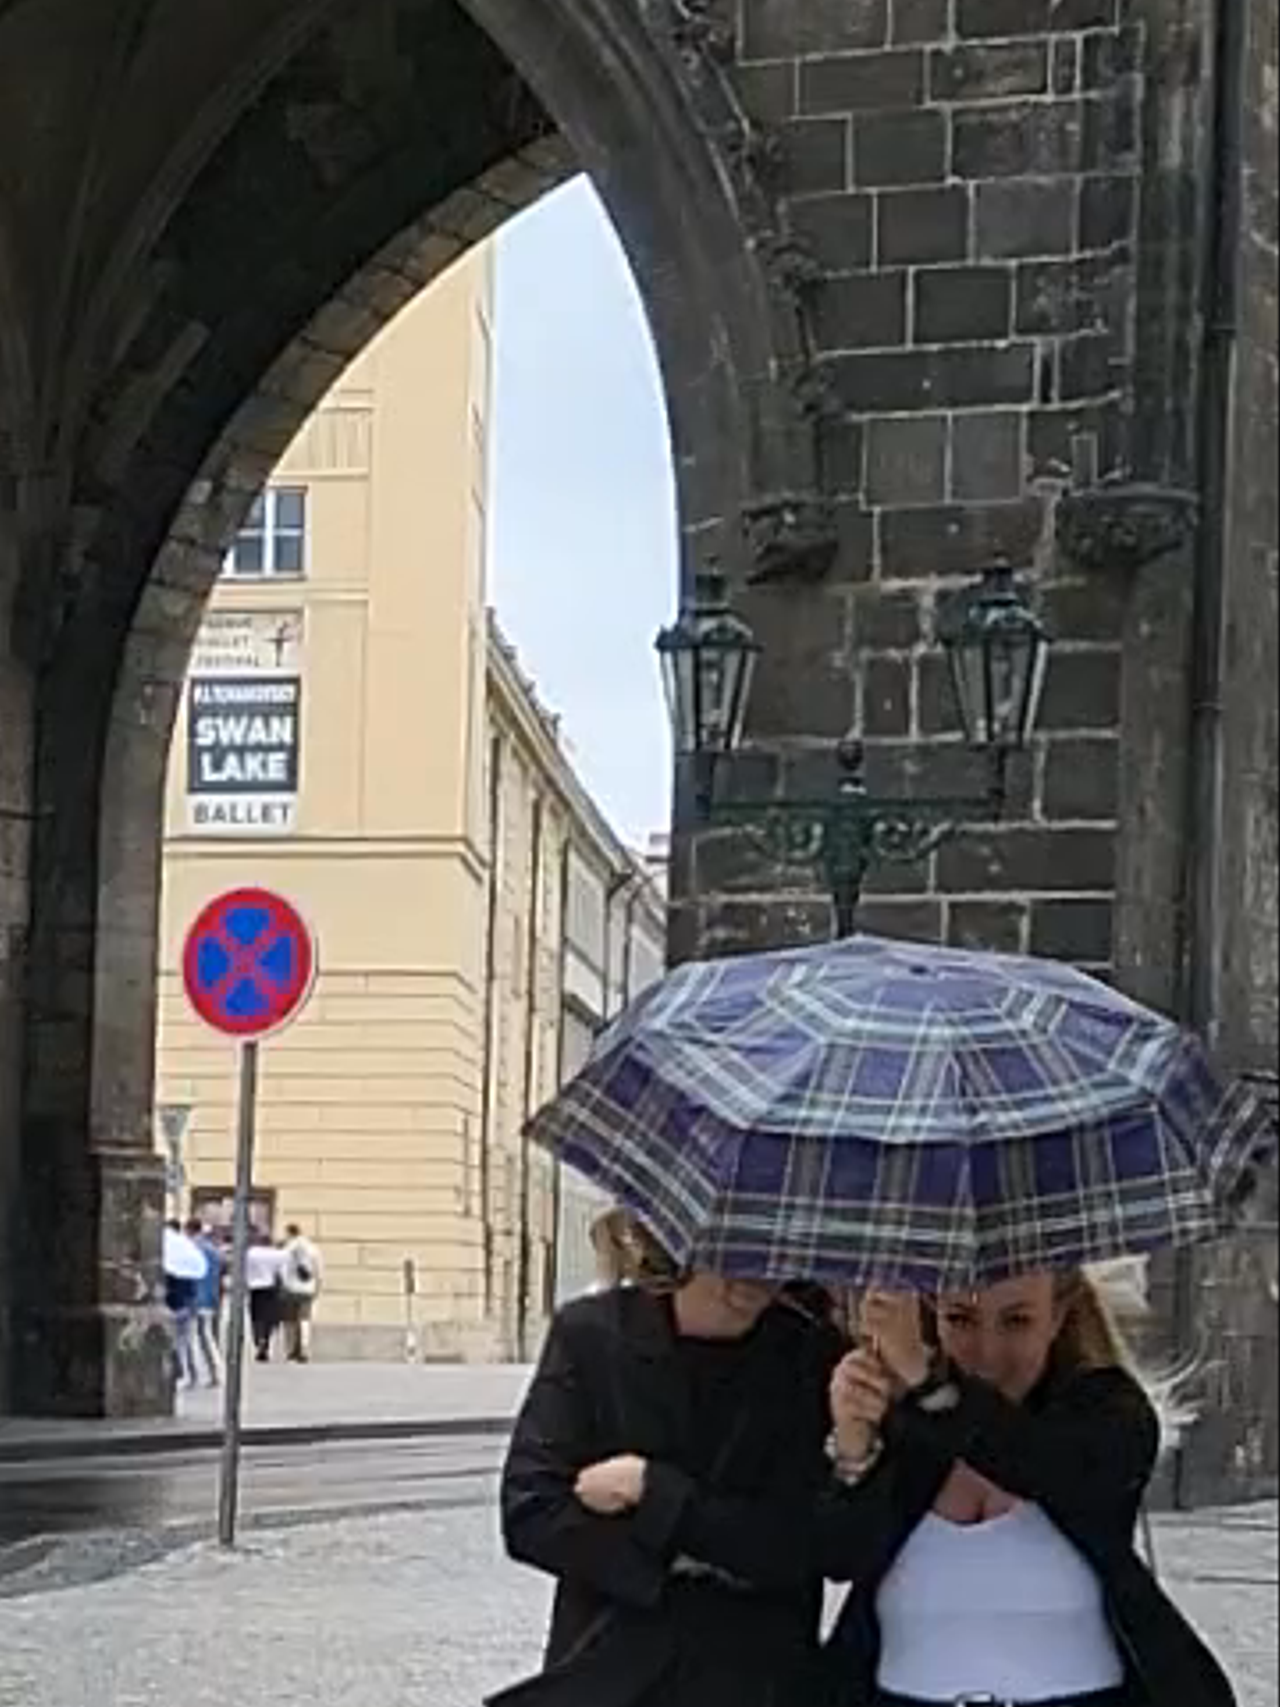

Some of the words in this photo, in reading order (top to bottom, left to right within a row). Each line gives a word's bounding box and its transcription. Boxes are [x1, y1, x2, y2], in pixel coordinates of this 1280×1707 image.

[196, 715, 294, 746] SWAN
[200, 751, 289, 782] LAKE
[193, 802, 293, 825] BALLET
